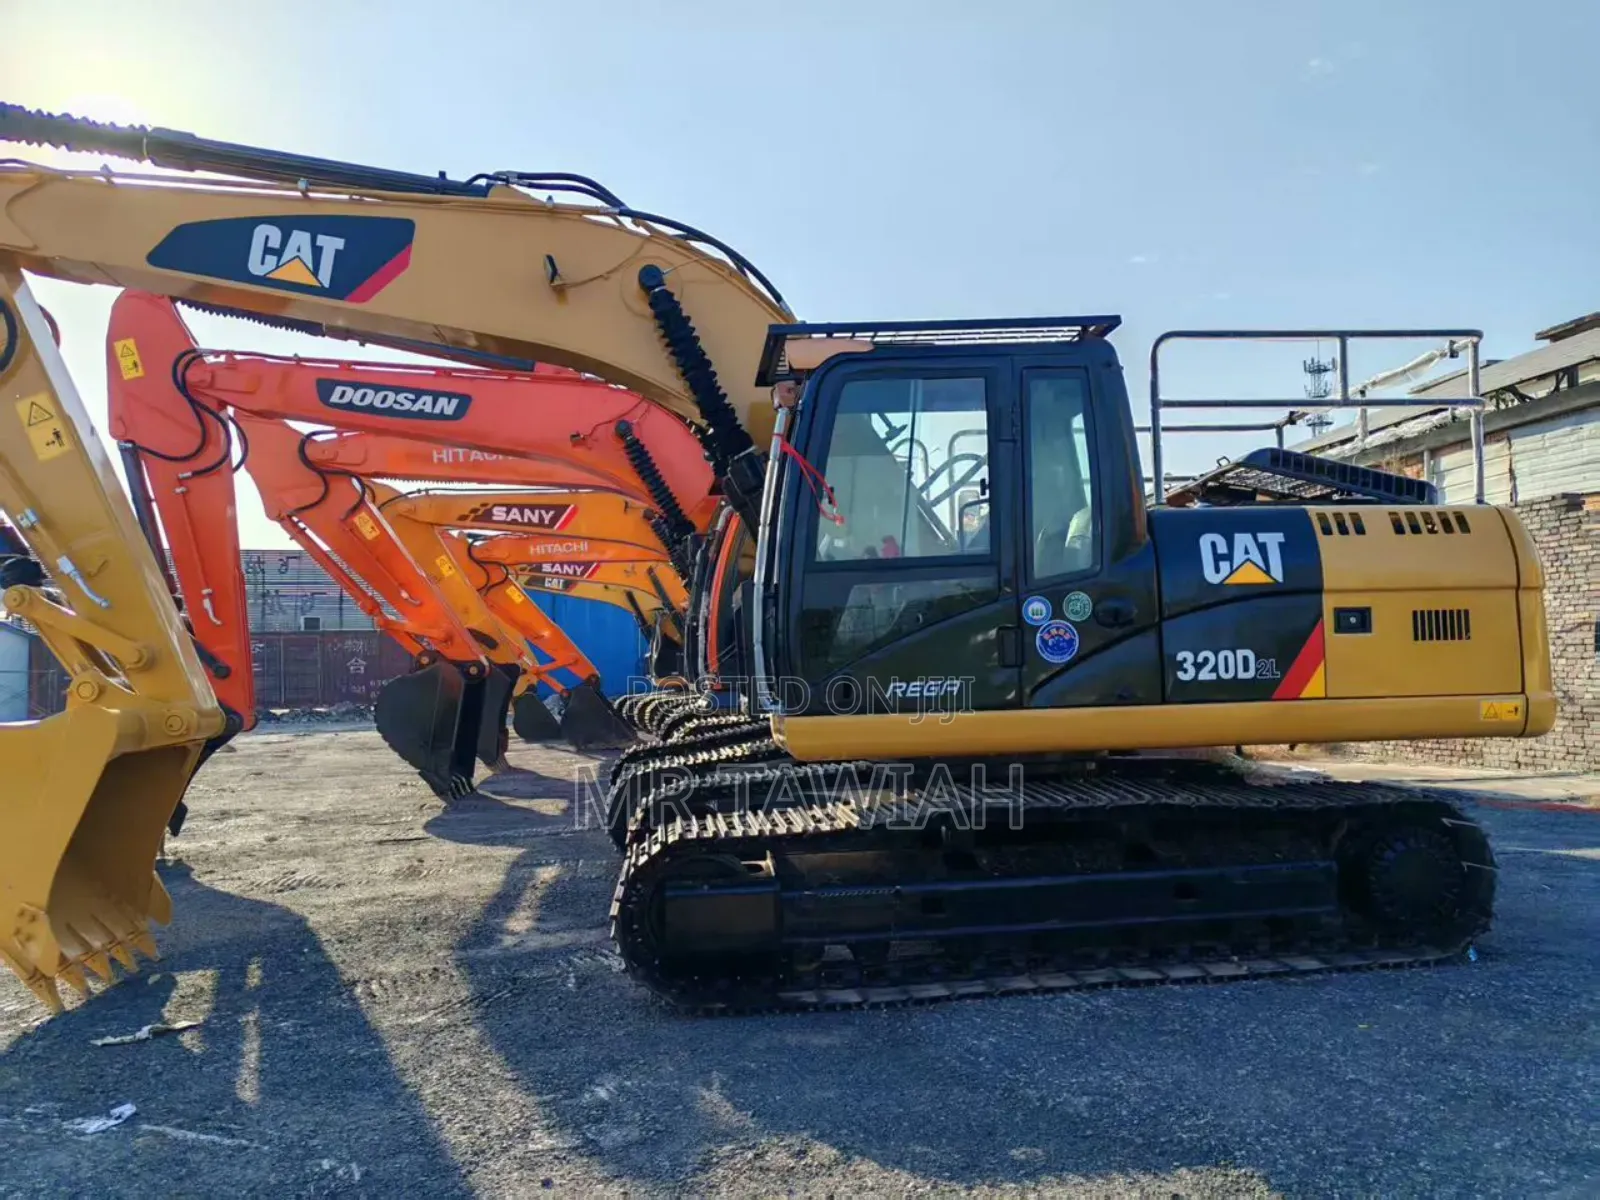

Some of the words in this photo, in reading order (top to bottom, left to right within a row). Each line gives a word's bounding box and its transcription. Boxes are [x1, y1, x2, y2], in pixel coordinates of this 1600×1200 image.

[248, 224, 345, 288] CAT
[330, 385, 459, 416] DOOSAN
[491, 506, 555, 525] SANY
[529, 540, 588, 555] HITACHI
[1199, 532, 1285, 585] CAT
[541, 563, 585, 576] SANY
[885, 679, 961, 698] REGA
